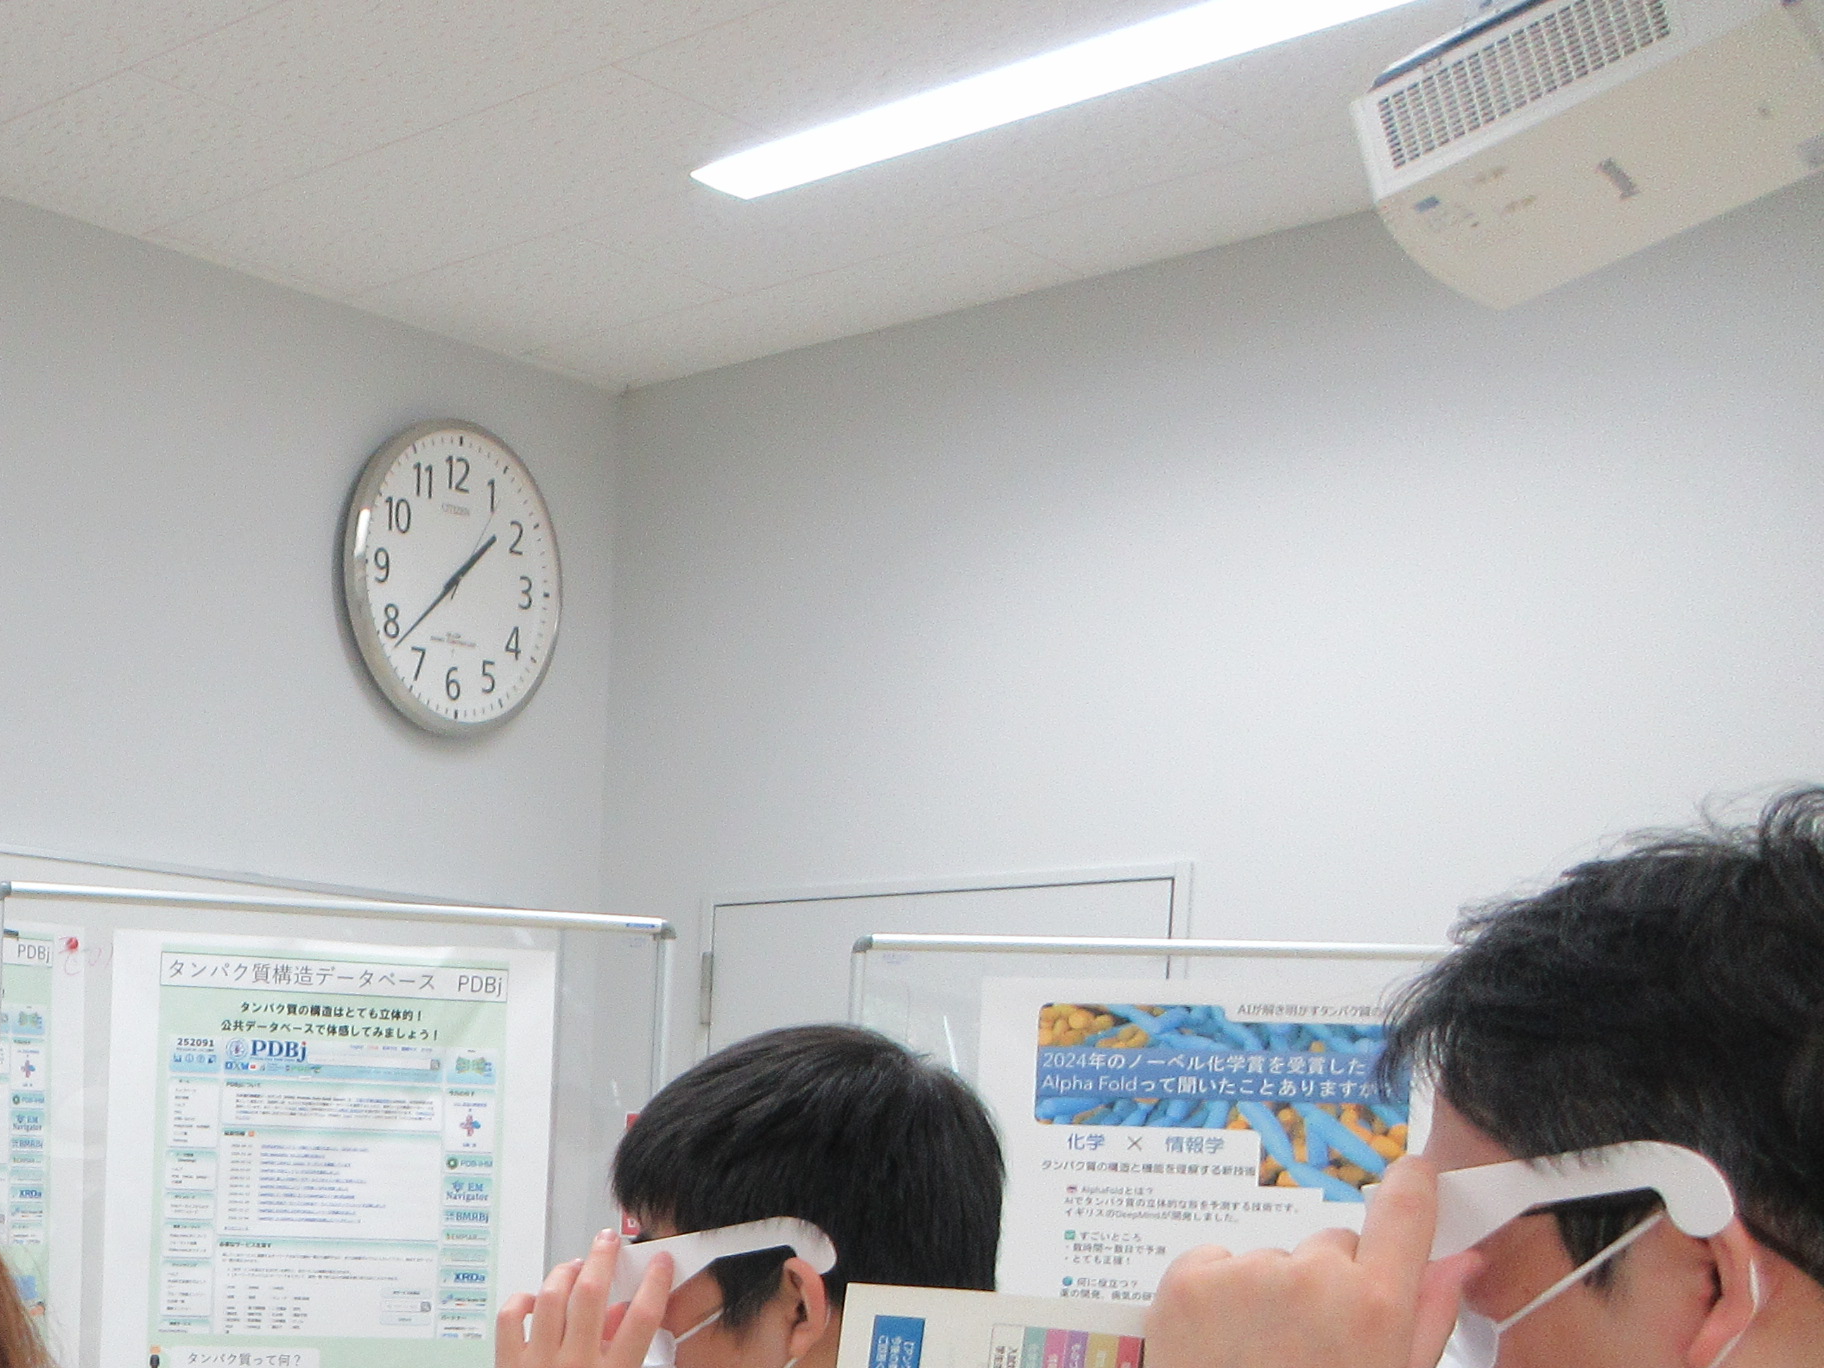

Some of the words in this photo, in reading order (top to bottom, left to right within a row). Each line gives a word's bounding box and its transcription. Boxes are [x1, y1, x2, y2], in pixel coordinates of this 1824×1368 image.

[414, 462, 433, 499] 11
[445, 455, 470, 493] 12
[487, 478, 496, 513] 1
[385, 496, 411, 534] 10
[509, 521, 523, 555] 2
[374, 547, 390, 583] 9
[518, 576, 532, 611] 3
[384, 603, 400, 639] 8
[505, 626, 521, 660] 4
[411, 646, 426, 681] 7
[481, 660, 495, 694] 5
[445, 667, 461, 700] 6
[17, 943, 51, 964] PDBj
[168, 958, 437, 993] タンパク質構造データベース
[457, 975, 503, 998] PDBj
[240, 1001, 423, 1023] タンパク質の構造はとても立体的！
[177, 1038, 214, 1047] 252091
[220, 1019, 440, 1042] 公共データベースで体感してみましょう！
[250, 1039, 307, 1063] PDBj
[1043, 1051, 1366, 1076] 2024年のノーベル化学賞を受賞した
[1042, 1075, 1093, 1092] Alpha
[1066, 1133, 1105, 1151] 化学
[1165, 1134, 1225, 1153] 情報学
[1041, 1159, 1256, 1177] タンパク質の構造と機能を理解する新技術
[446, 1190, 489, 1203] Navigator
[1080, 1230, 1142, 1242] すごいところ
[188, 1352, 302, 1368] タンパク質って何？
